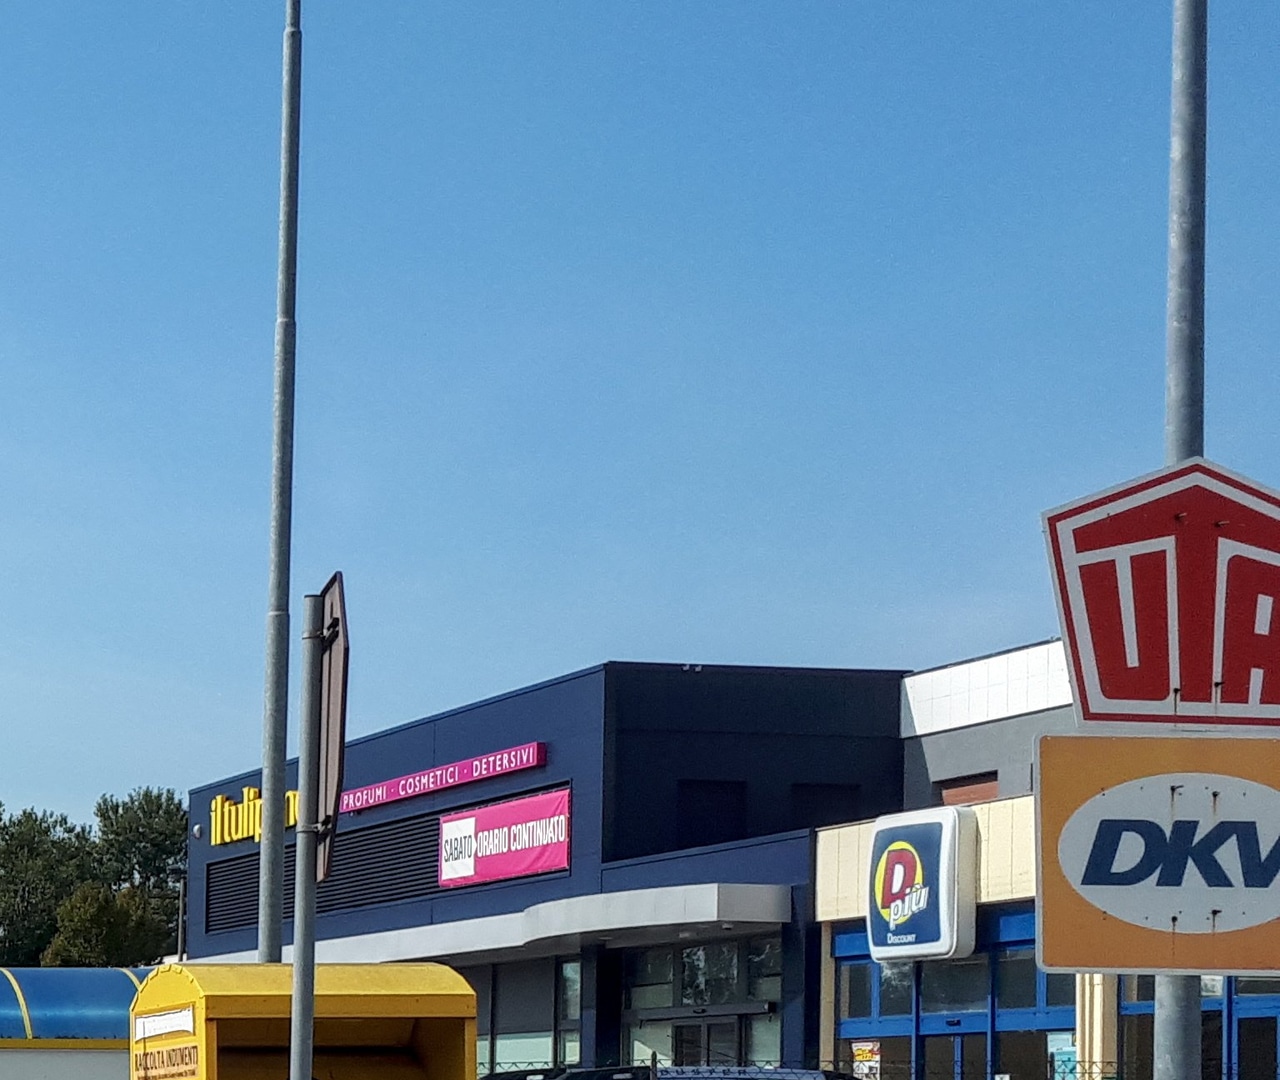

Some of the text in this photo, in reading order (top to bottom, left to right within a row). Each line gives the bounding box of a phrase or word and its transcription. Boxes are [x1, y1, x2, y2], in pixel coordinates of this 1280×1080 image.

[342, 747, 534, 809] PROFUMI COSMETICI DETERSIVI
[443, 815, 565, 863] SABATO ORARIO CONTINUATO
[1080, 818, 1280, 889] DKV
